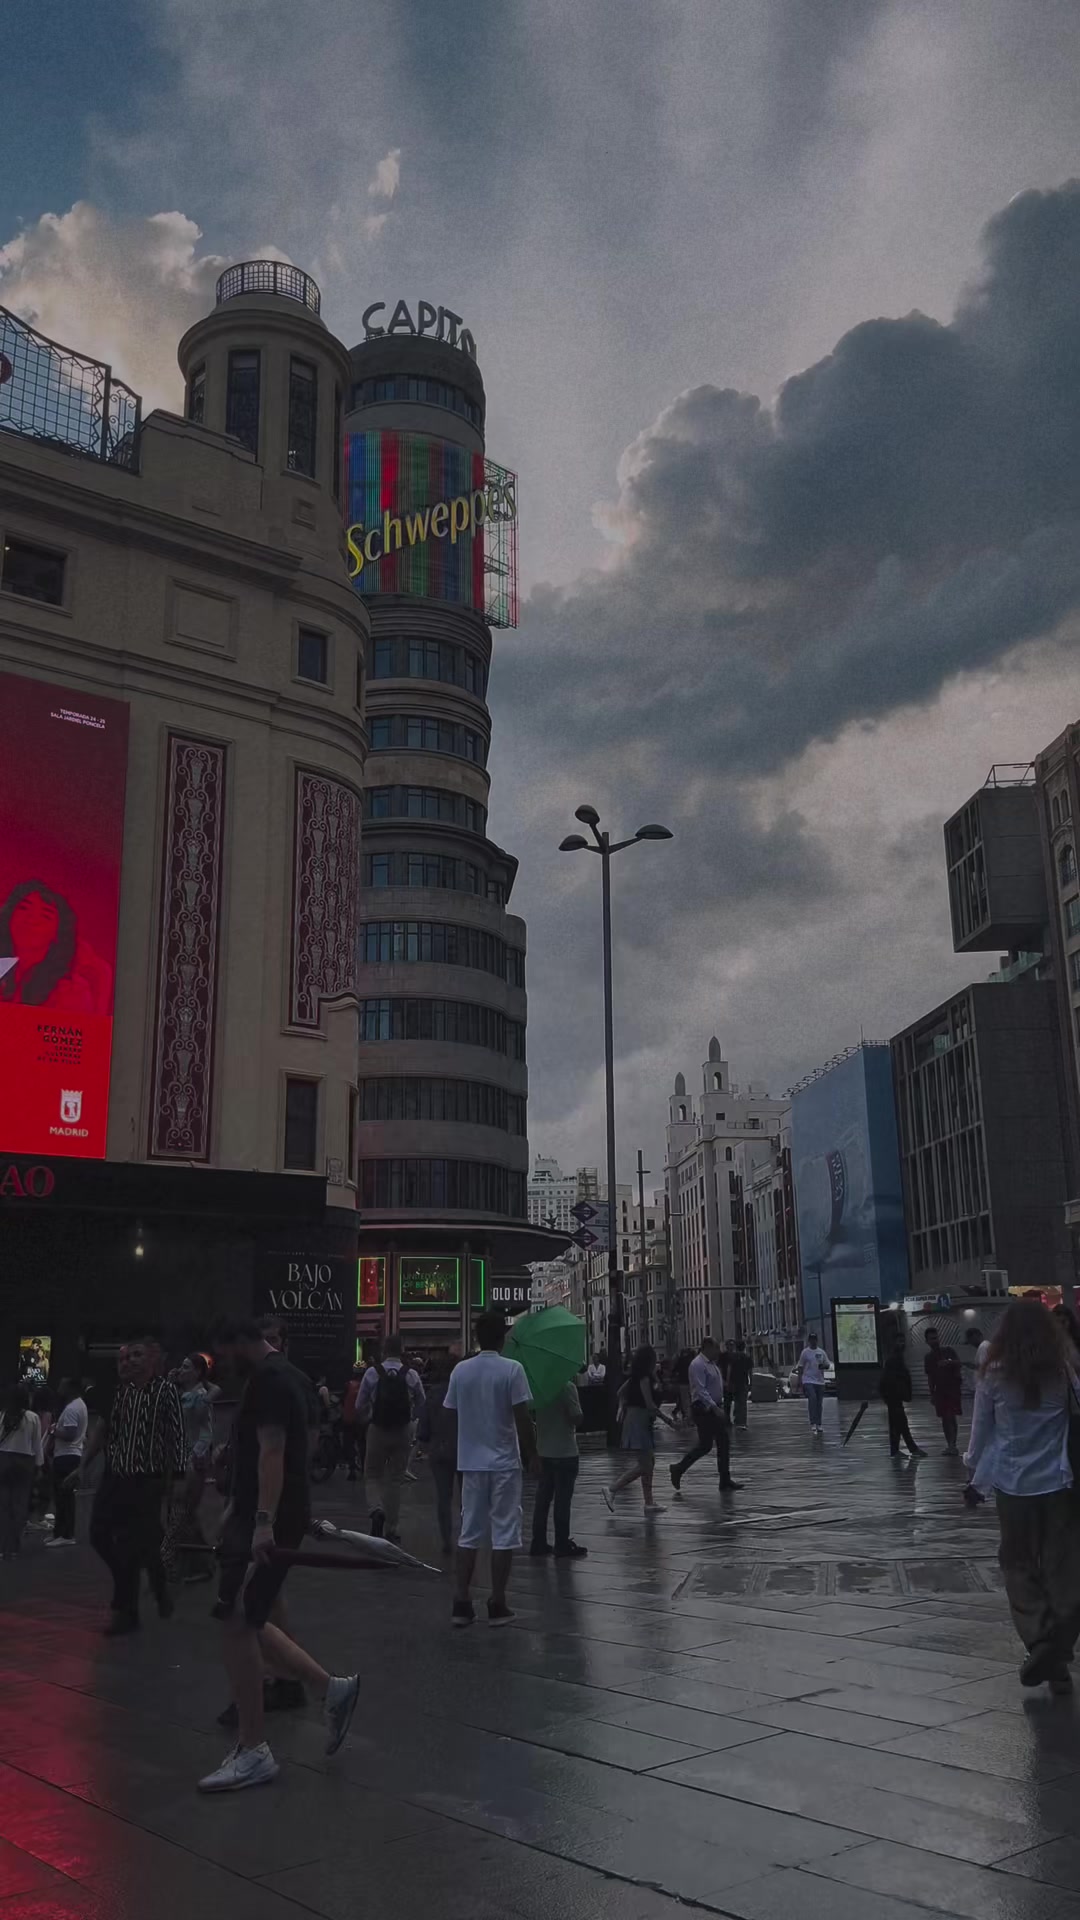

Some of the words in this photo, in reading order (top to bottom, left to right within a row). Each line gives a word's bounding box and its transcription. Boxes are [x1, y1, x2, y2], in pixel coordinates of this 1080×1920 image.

[362, 299, 477, 358] CAPITO
[345, 481, 517, 579] Schweppes
[50, 712, 63, 720] SALA
[82, 720, 105, 729] PONCELA
[60, 708, 90, 719] TEMPORADA
[49, 1126, 89, 1138] MADRID
[288, 1263, 332, 1291] BAJO
[269, 1287, 343, 1311] VOLCÁN
[490, 1287, 511, 1301] OLO
[513, 1287, 524, 1302] EN
